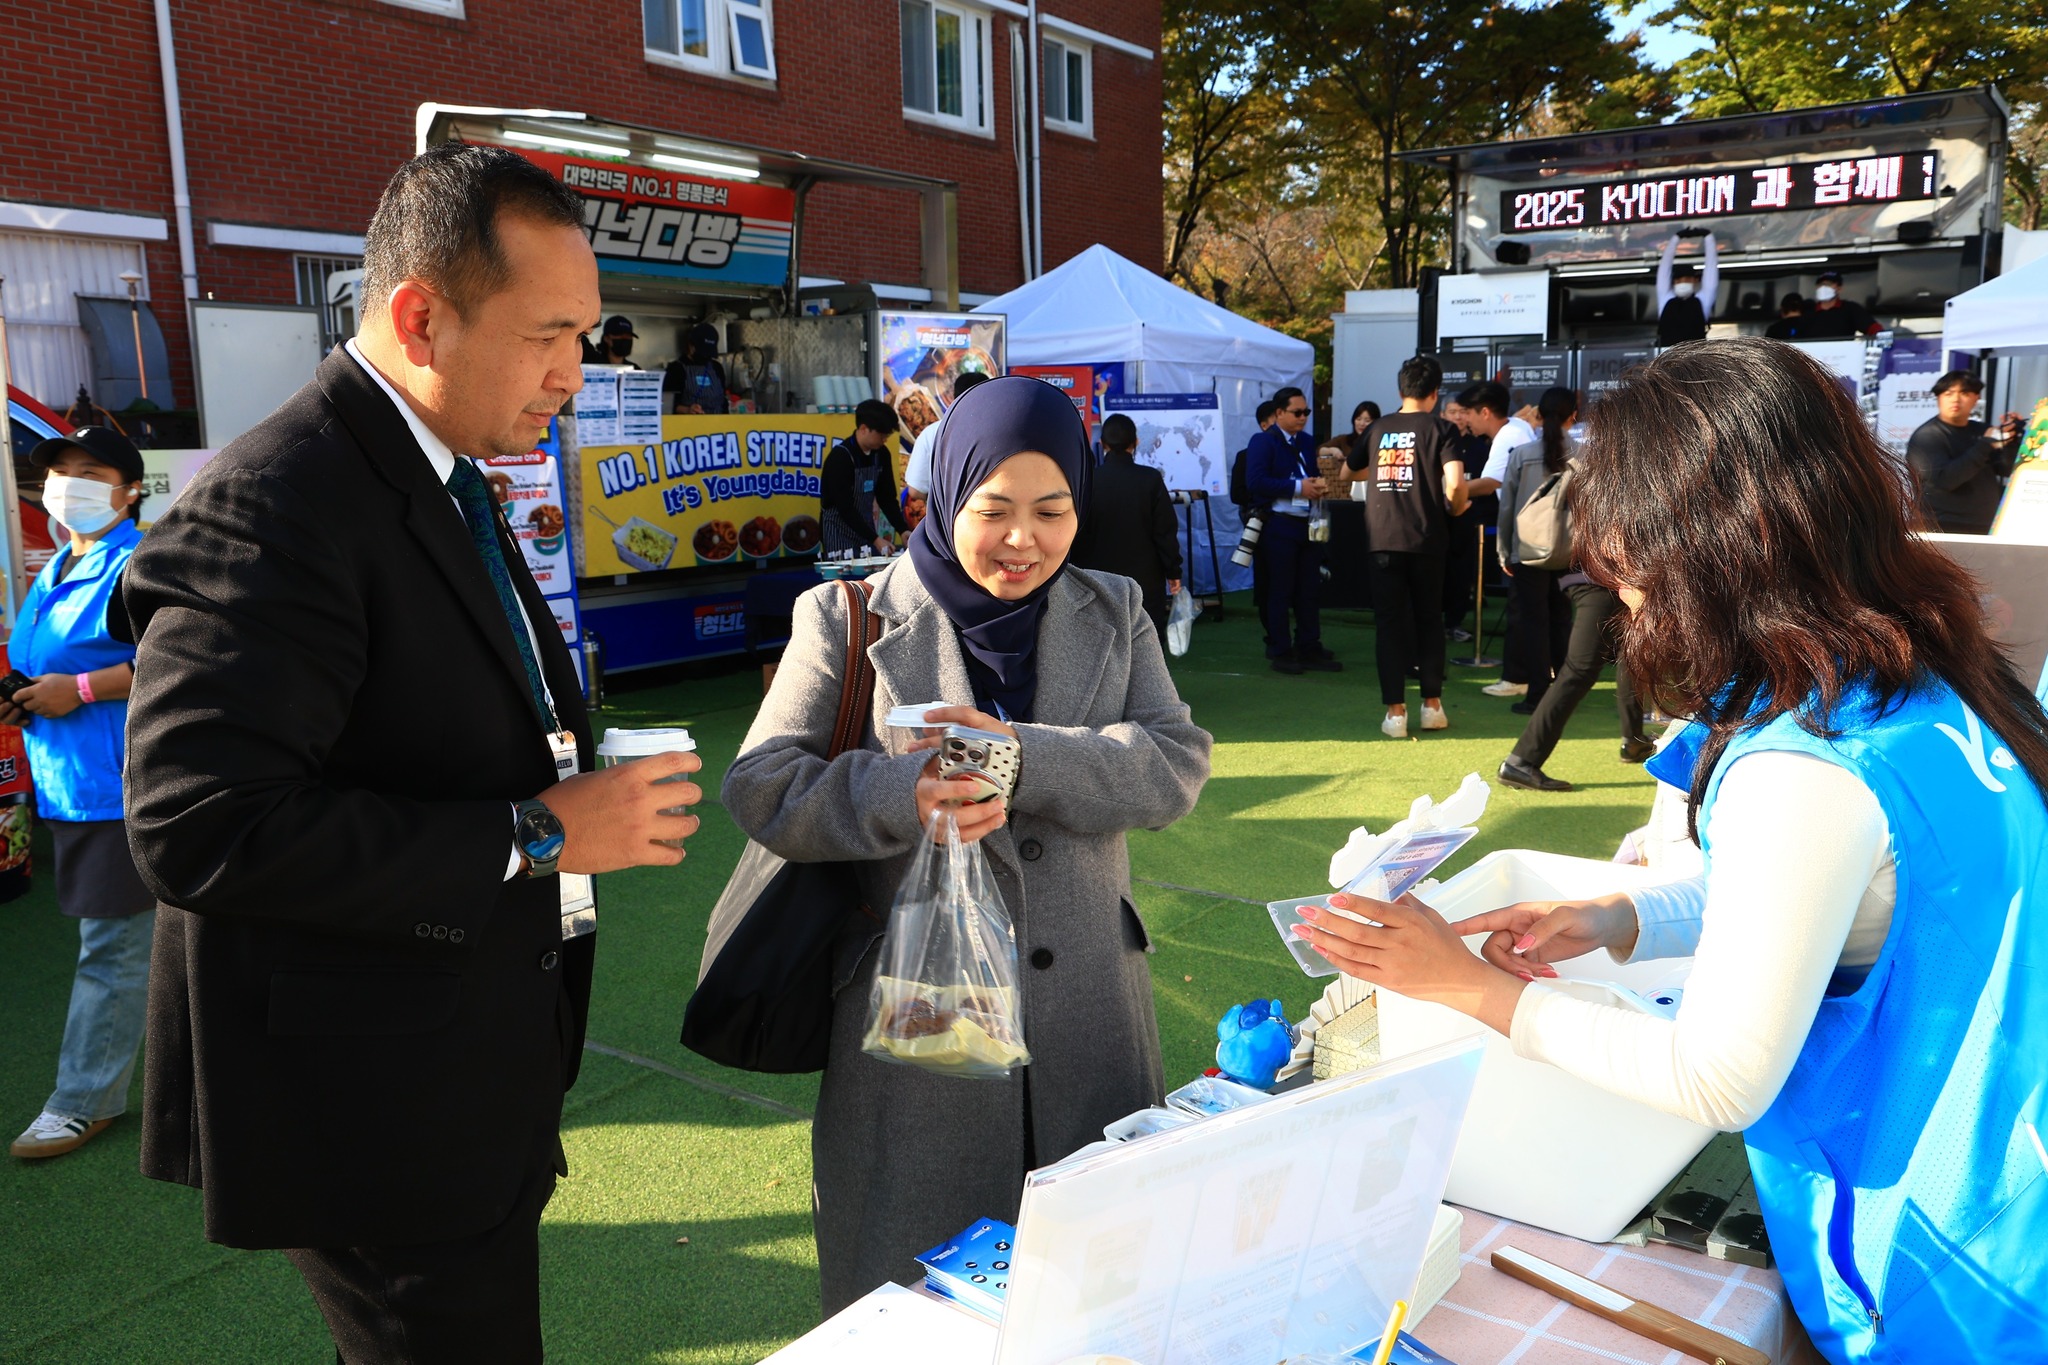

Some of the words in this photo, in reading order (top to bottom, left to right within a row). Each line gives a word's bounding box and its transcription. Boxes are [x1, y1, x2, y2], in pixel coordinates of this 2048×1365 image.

[563, 164, 628, 193] 대한민국
[631, 176, 672, 199] NO.1
[676, 182, 728, 206] 명품분식
[1514, 188, 1585, 228] 2025
[1601, 174, 1736, 221] KYOCHON
[1751, 166, 1795, 208] 과
[1813, 155, 1904, 204] 함께
[584, 198, 741, 268] 년다방
[662, 431, 741, 479] KOREA
[746, 430, 826, 468] STREET
[1378, 448, 1415, 466] 2025
[1379, 431, 1416, 449] APEC
[1377, 465, 1413, 481] KOREA
[662, 483, 702, 516] It's
